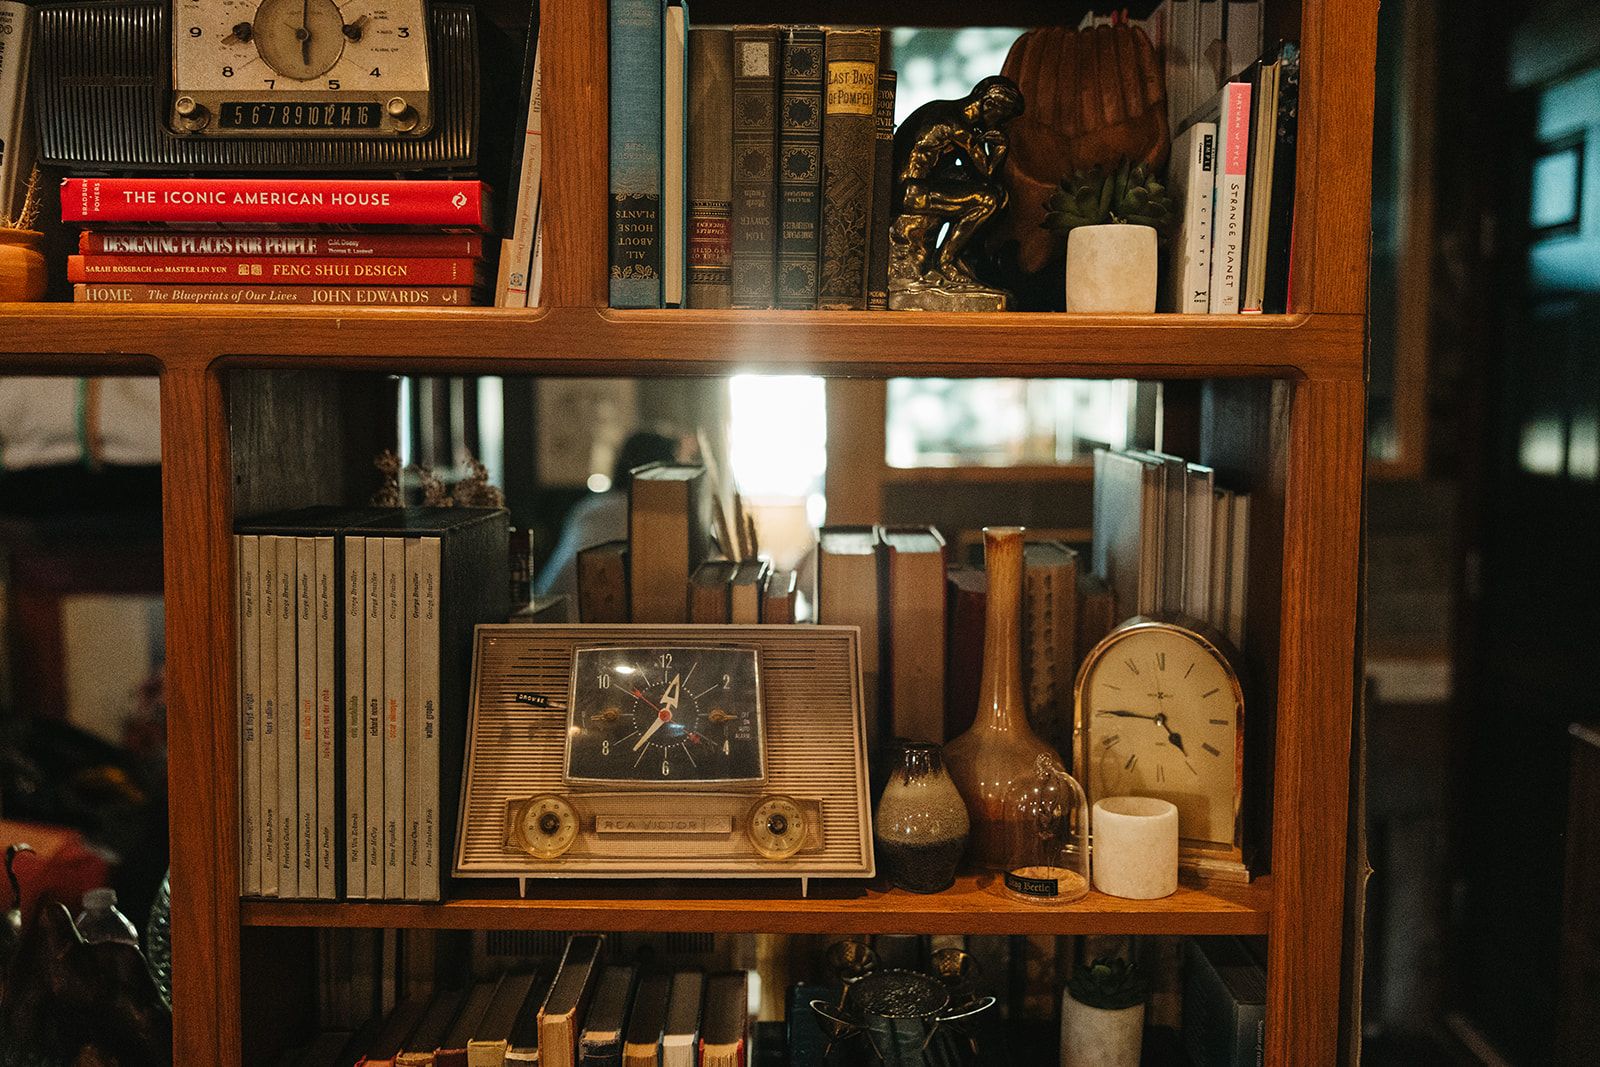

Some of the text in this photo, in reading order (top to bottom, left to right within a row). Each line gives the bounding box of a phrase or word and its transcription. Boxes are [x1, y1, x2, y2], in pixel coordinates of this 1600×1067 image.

[189, 27, 202, 38] 9
[398, 28, 410, 38] 3
[222, 67, 234, 77] 8
[369, 68, 382, 78] 4
[828, 70, 874, 85] LAST DAYS
[264, 80, 276, 90] 7
[328, 80, 341, 90] 5
[234, 106, 368, 125] 5 6 7 8 9 10 12 14 16
[1204, 136, 1212, 170] SIMPLE
[123, 191, 390, 206] THE ICONIC AMERICAN HOUSE
[615, 210, 656, 218] PLANTS
[1228, 183, 1239, 237] STRANGE
[740, 217, 770, 225] SAWYER
[617, 224, 653, 232] HOUSE
[617, 237, 653, 246] ABOUT
[745, 232, 766, 240] TOM
[102, 235, 318, 254] DESIGNING PLACES FOR PEOPLE
[626, 251, 646, 259] ALL
[273, 265, 311, 276] FENG
[315, 265, 350, 276] SHUI
[354, 265, 407, 276] DESIGN
[1225, 244, 1235, 288] PLANET
[86, 288, 133, 301] HOME
[149, 290, 297, 303] The Blueprints of Our Lives
[311, 290, 429, 303] JOHN EDWARDS
[659, 654, 672, 668] 12
[597, 674, 610, 689] 10
[723, 674, 730, 689] 2
[370, 718, 378, 736] richard
[602, 740, 610, 755] 8
[723, 740, 730, 755] 4
[662, 760, 669, 776] 6
[605, 820, 697, 830] RCA VICTOR
[1023, 881, 1050, 892] Beetle
